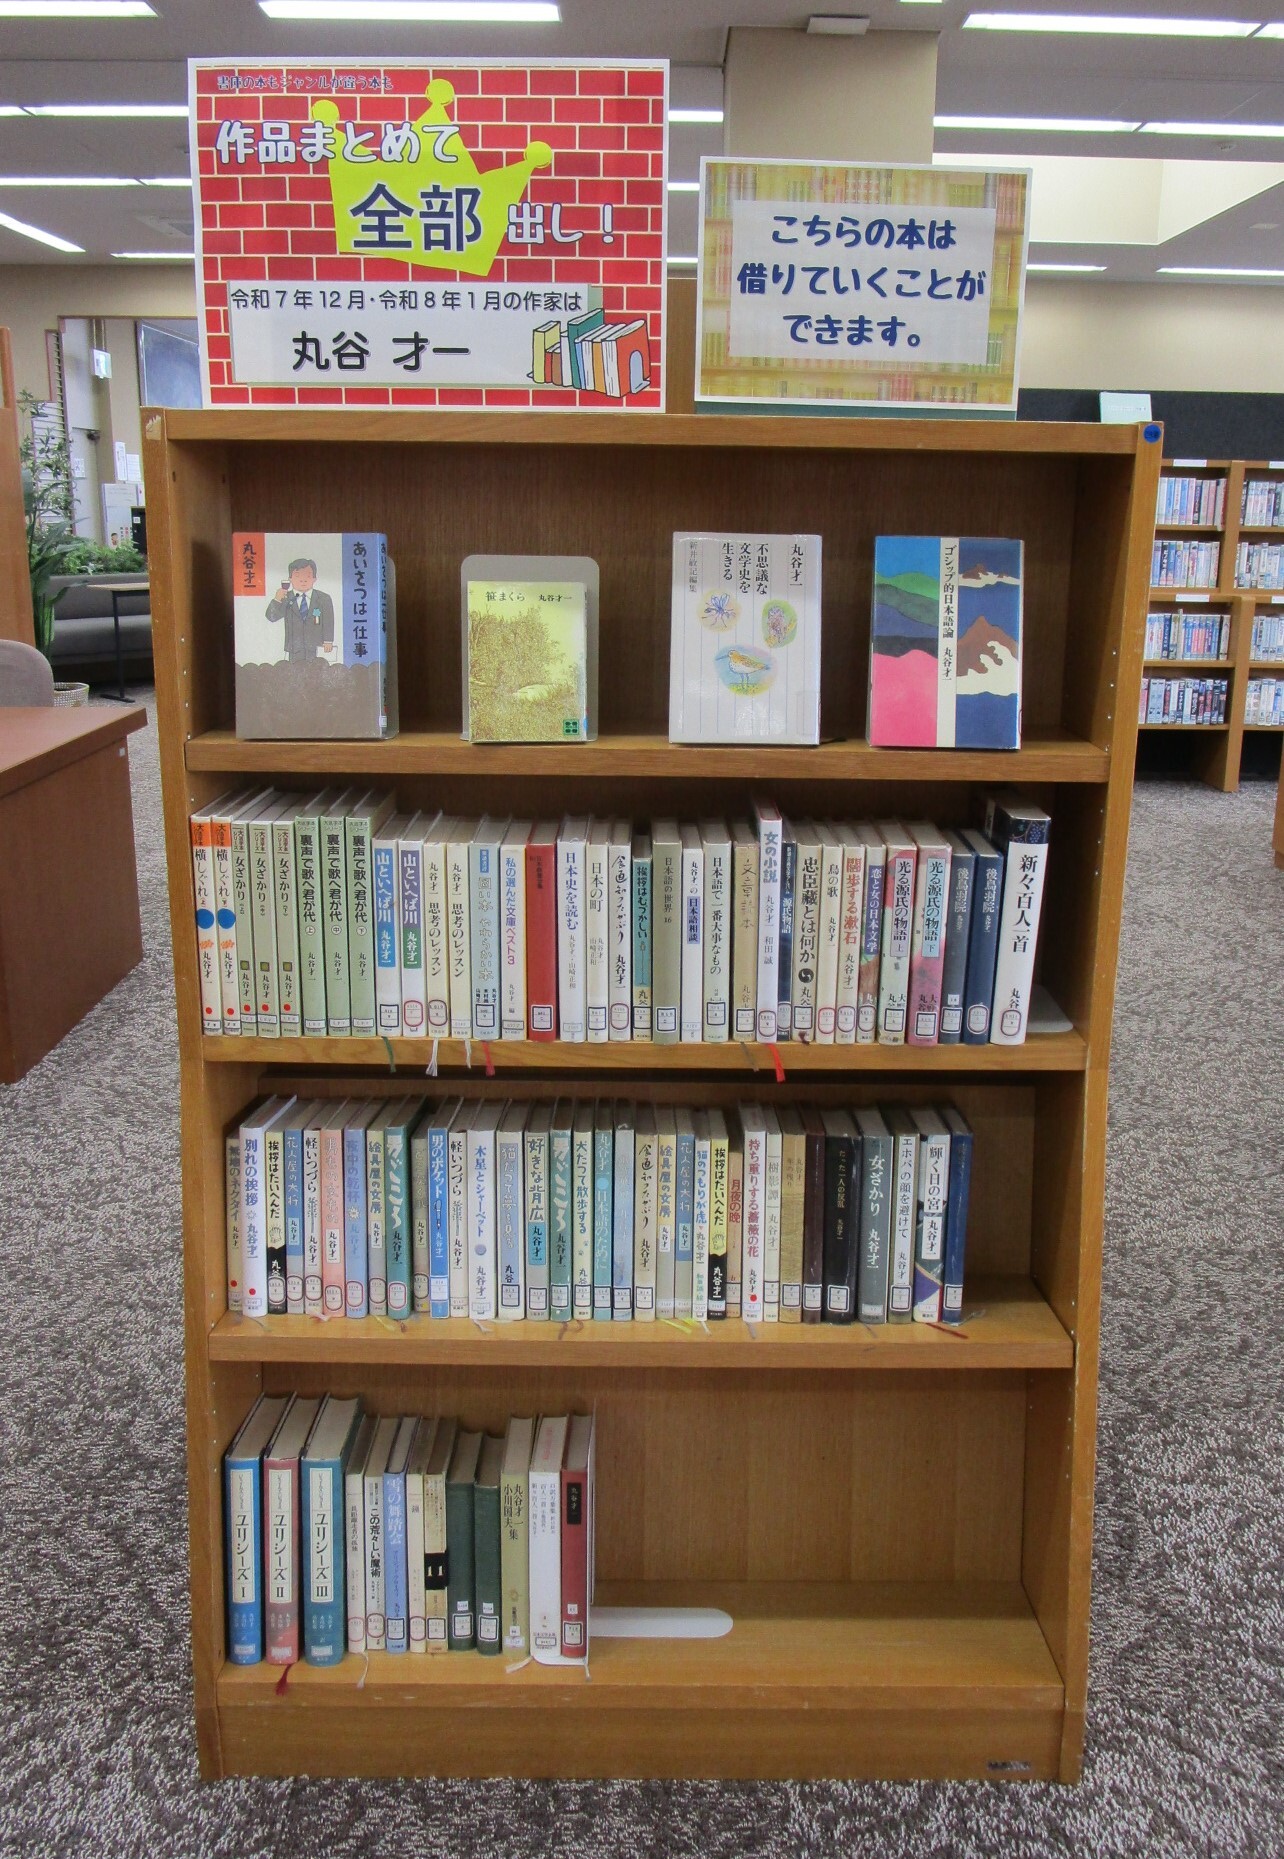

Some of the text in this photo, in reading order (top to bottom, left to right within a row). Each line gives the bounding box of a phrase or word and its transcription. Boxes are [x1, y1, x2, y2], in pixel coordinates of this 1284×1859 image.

[217, 74, 393, 91] 書庫の本もジャンルが違う本も
[214, 120, 461, 165] 作品まとめて
[348, 181, 484, 254] 全部
[771, 214, 957, 250] こちらの本は
[737, 263, 987, 301] 借りていくことが
[782, 314, 922, 348] できます。
[242, 541, 257, 588] 丸谷才一
[722, 542, 734, 581] 生きる
[739, 542, 751, 594] 文学史を
[755, 543, 769, 595] 不思議な
[789, 543, 804, 587] 丸谷才一
[352, 541, 369, 658] あいさつは一仕事
[485, 591, 572, 603] 笹まくら 丸谷才一
[942, 545, 957, 681] ゴシップ的日本語論 丸谷才一
[300, 834, 316, 923] 裏声で歌へ君が代
[327, 834, 342, 922] 裏声で歌へ君が代
[352, 835, 368, 923] 裏声で歌へ君が代
[763, 831, 778, 884] 女の小説
[827, 863, 839, 898] 鳥の歌
[377, 852, 391, 963] 山といへば川 丸谷才一
[403, 853, 418, 964] 山といへば川 丸谷才一
[505, 857, 516, 965] 私の選んだ文庫ベスト3
[564, 852, 578, 930] 日本史を読む
[590, 862, 603, 912] 日本の町
[663, 857, 674, 913] 日本語の世界
[765, 895, 774, 927] 丸谷才一
[867, 868, 882, 953] 恋と女の日本文学
[893, 861, 911, 941] 光る源氏の物語
[925, 861, 943, 941] 光る源氏の物語
[954, 868, 969, 913] 後鳥羽院
[983, 868, 998, 913] 後鳥羽院
[1012, 855, 1038, 953] 新々百人一首
[428, 862, 441, 976] 丸谷才一 思考のレッスン
[452, 863, 464, 978] 丸谷才一 思考のレッスン
[710, 857, 723, 975] 日本語で一番大事なもの
[843, 857, 862, 990] 闊歩する漱石 丸谷才一
[203, 951, 213, 984] 丸谷才一
[224, 951, 234, 984] 丸谷才一
[615, 955, 626, 989] 丸谷才一
[245, 1139, 258, 1206] 別れの挨拶
[268, 1140, 280, 1219] 挨拶はたいへんだ
[305, 1137, 318, 1193] 軽いつづら
[368, 1141, 382, 1214] 絵具屋の女房
[431, 1135, 444, 1199] 男のポケット
[450, 1141, 463, 1196] 軽いつづら
[475, 1145, 487, 1237] 木星とシャーベット
[527, 1138, 545, 1221] 好きな背広
[660, 1145, 673, 1218] 絵具屋の女房
[696, 1150, 708, 1224] 猫のつもりが虎
[714, 1147, 726, 1226] 挨拶はたいへんだ
[767, 1162, 779, 1201] 樹影譚
[868, 1154, 886, 1217] 女ざかり
[898, 1138, 913, 1239] エホバの顔を避けて
[927, 1146, 943, 1211] 輝く日の宮
[596, 1134, 610, 1269] 丸谷才一 日本語のために
[728, 1179, 742, 1224] 月夜の晩
[747, 1138, 761, 1258] 持ち重りする薔薇の花
[247, 1223, 258, 1258] 丸谷才一
[308, 1235, 318, 1267] 丸谷才一
[328, 1231, 337, 1261] 丸谷才一
[392, 1231, 403, 1265] 丸谷才一
[417, 1221, 425, 1246] 丸谷才一
[453, 1238, 463, 1270] 丸谷才一
[533, 1225, 542, 1261] 丸谷才一
[557, 1233, 566, 1268] 丸谷才一
[640, 1239, 650, 1272] 丸谷才一
[696, 1232, 705, 1264] 丸谷才一
[768, 1214, 778, 1251] 丸谷才一
[866, 1228, 880, 1269] 丸谷才一
[926, 1219, 939, 1255] 丸谷才一
[475, 1266, 486, 1300] 丸谷才一
[712, 1266, 723, 1298] 丸谷才一
[897, 1251, 907, 1285] 丸谷才一
[504, 1484, 513, 1528] 小川国夫
[514, 1483, 523, 1526] 丸谷才一
[235, 1514, 251, 1581] ユリシーズ
[273, 1514, 288, 1580] ユリシーズ
[315, 1513, 330, 1580] ユリシーズ
[370, 1508, 380, 1578] この荒々しい魔術
